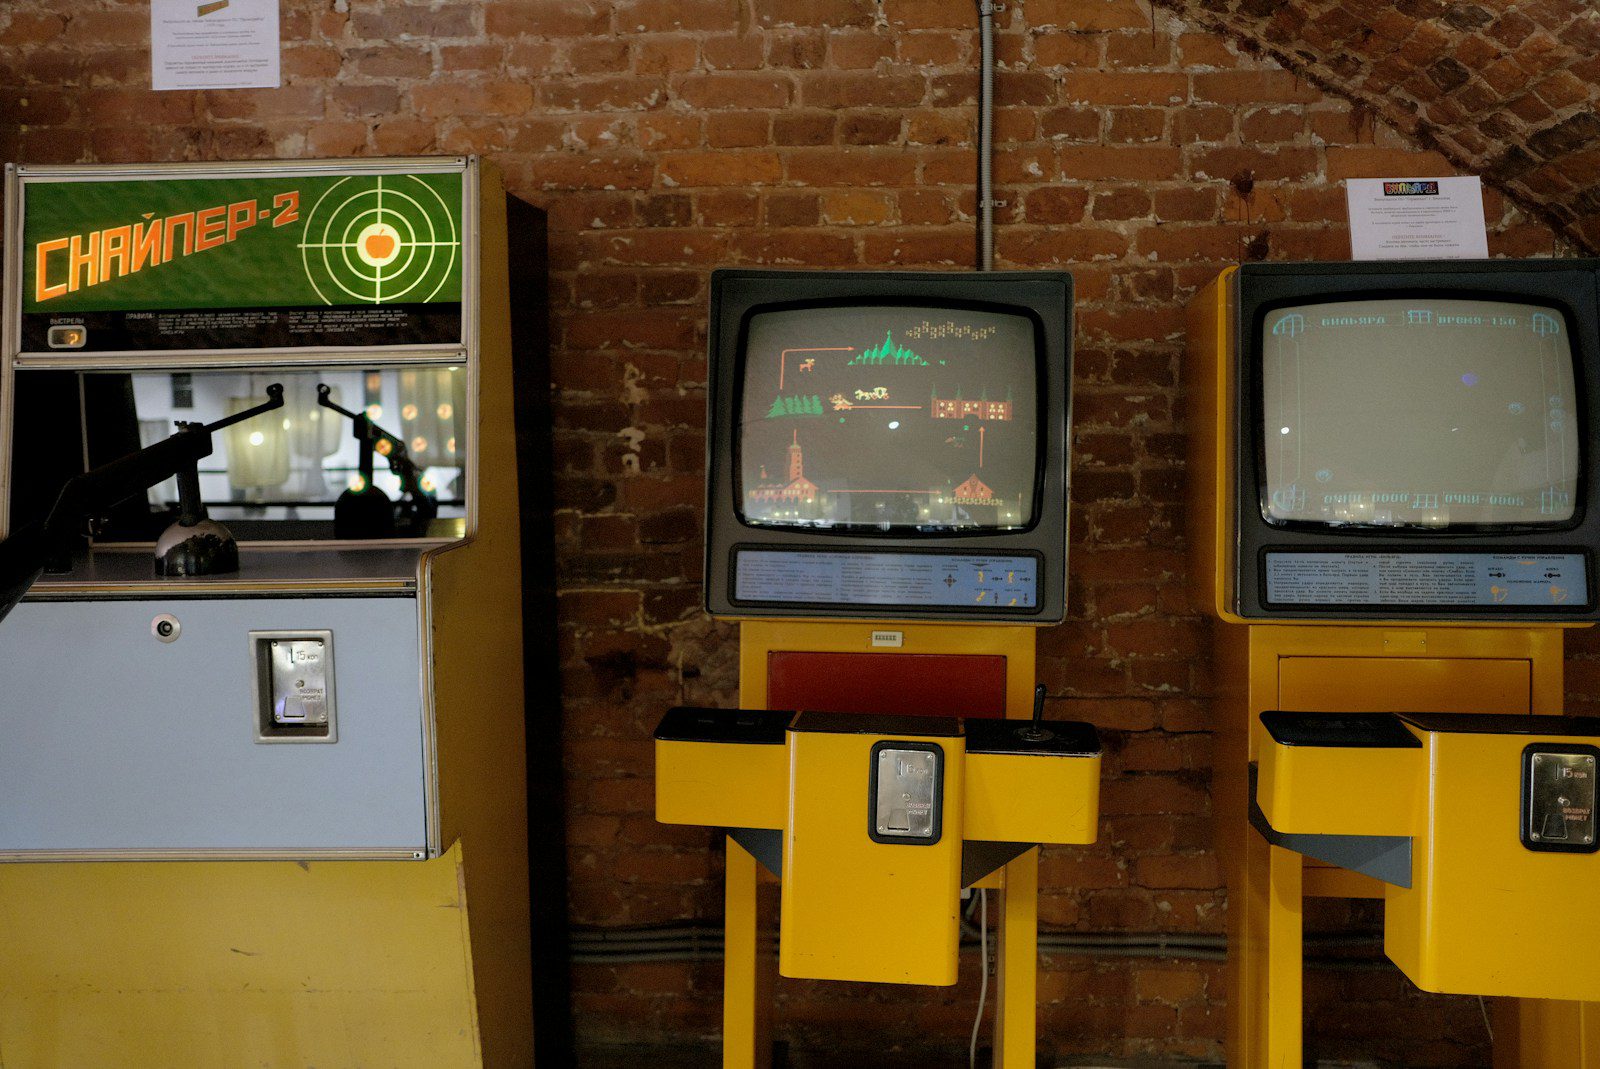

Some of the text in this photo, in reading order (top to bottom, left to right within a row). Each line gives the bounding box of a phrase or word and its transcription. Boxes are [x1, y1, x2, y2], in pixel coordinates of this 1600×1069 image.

[35, 190, 300, 303] СНАЙПЕР-2
[49, 317, 85, 325] ВЫСТРЕЛЫ
[296, 650, 305, 660] 15
[1562, 767, 1573, 779] 15
